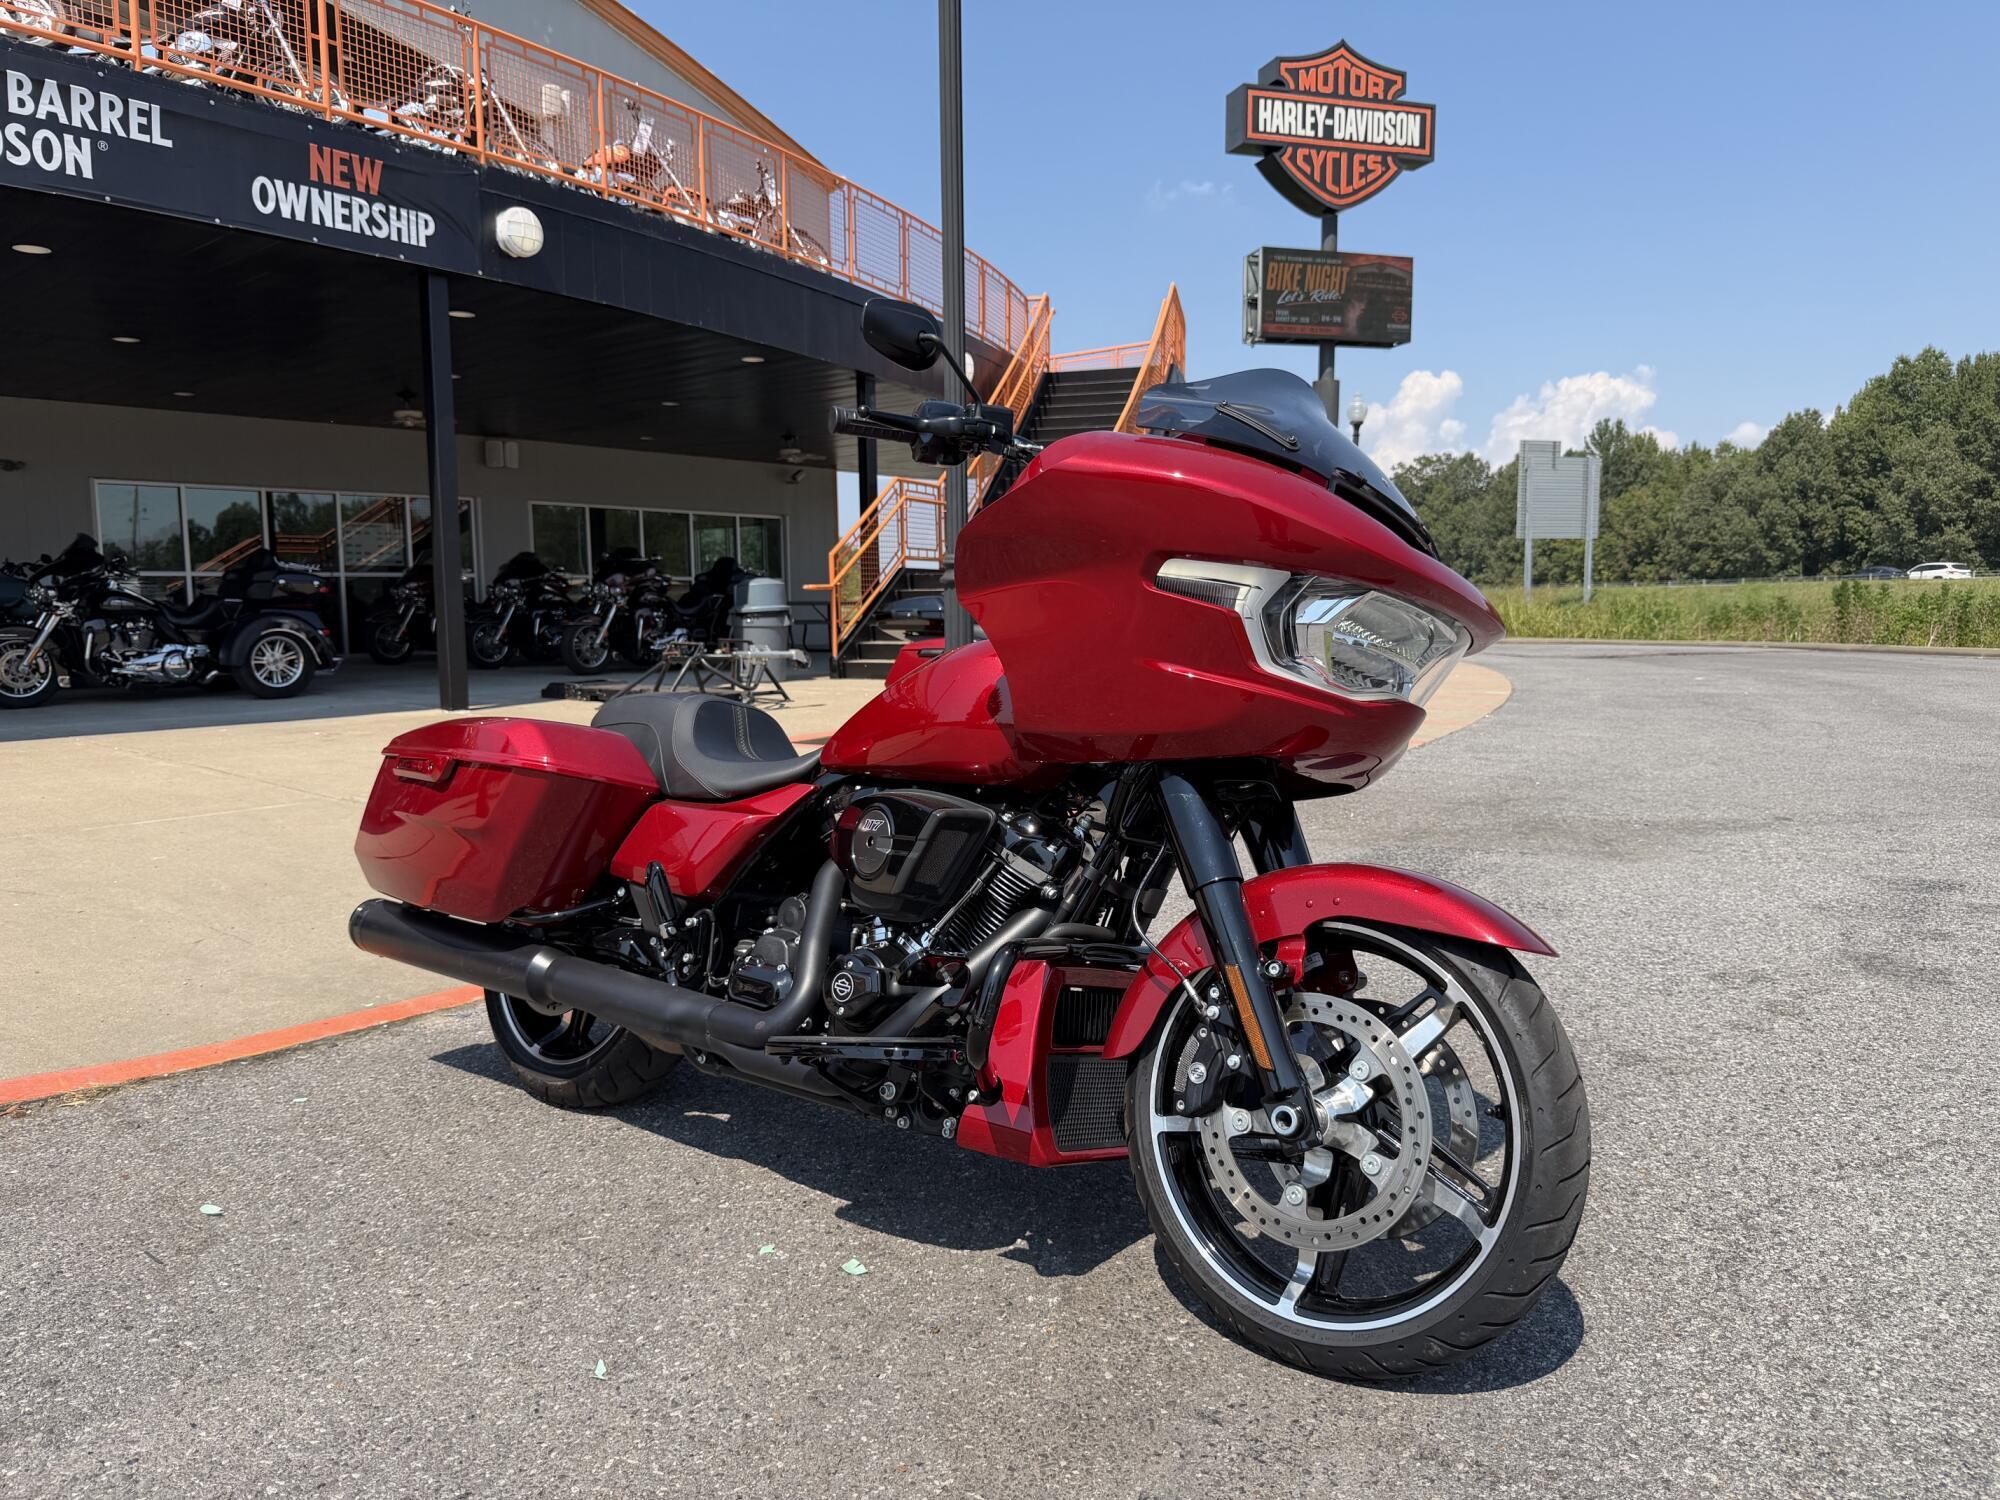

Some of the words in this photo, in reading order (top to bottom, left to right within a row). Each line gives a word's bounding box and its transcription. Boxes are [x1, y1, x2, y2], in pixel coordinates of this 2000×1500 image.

[1298, 57, 1385, 100] MOTOR
[6, 69, 173, 148] BARREL
[1258, 98, 1421, 147] HARLEY-DAVIDSON
[308, 143, 383, 196] NEW
[1296, 147, 1381, 195] CYCLES
[252, 176, 436, 248] OWNERSHIP
[1266, 262, 1303, 291] BIKE
[1304, 263, 1350, 294] NIGHT
